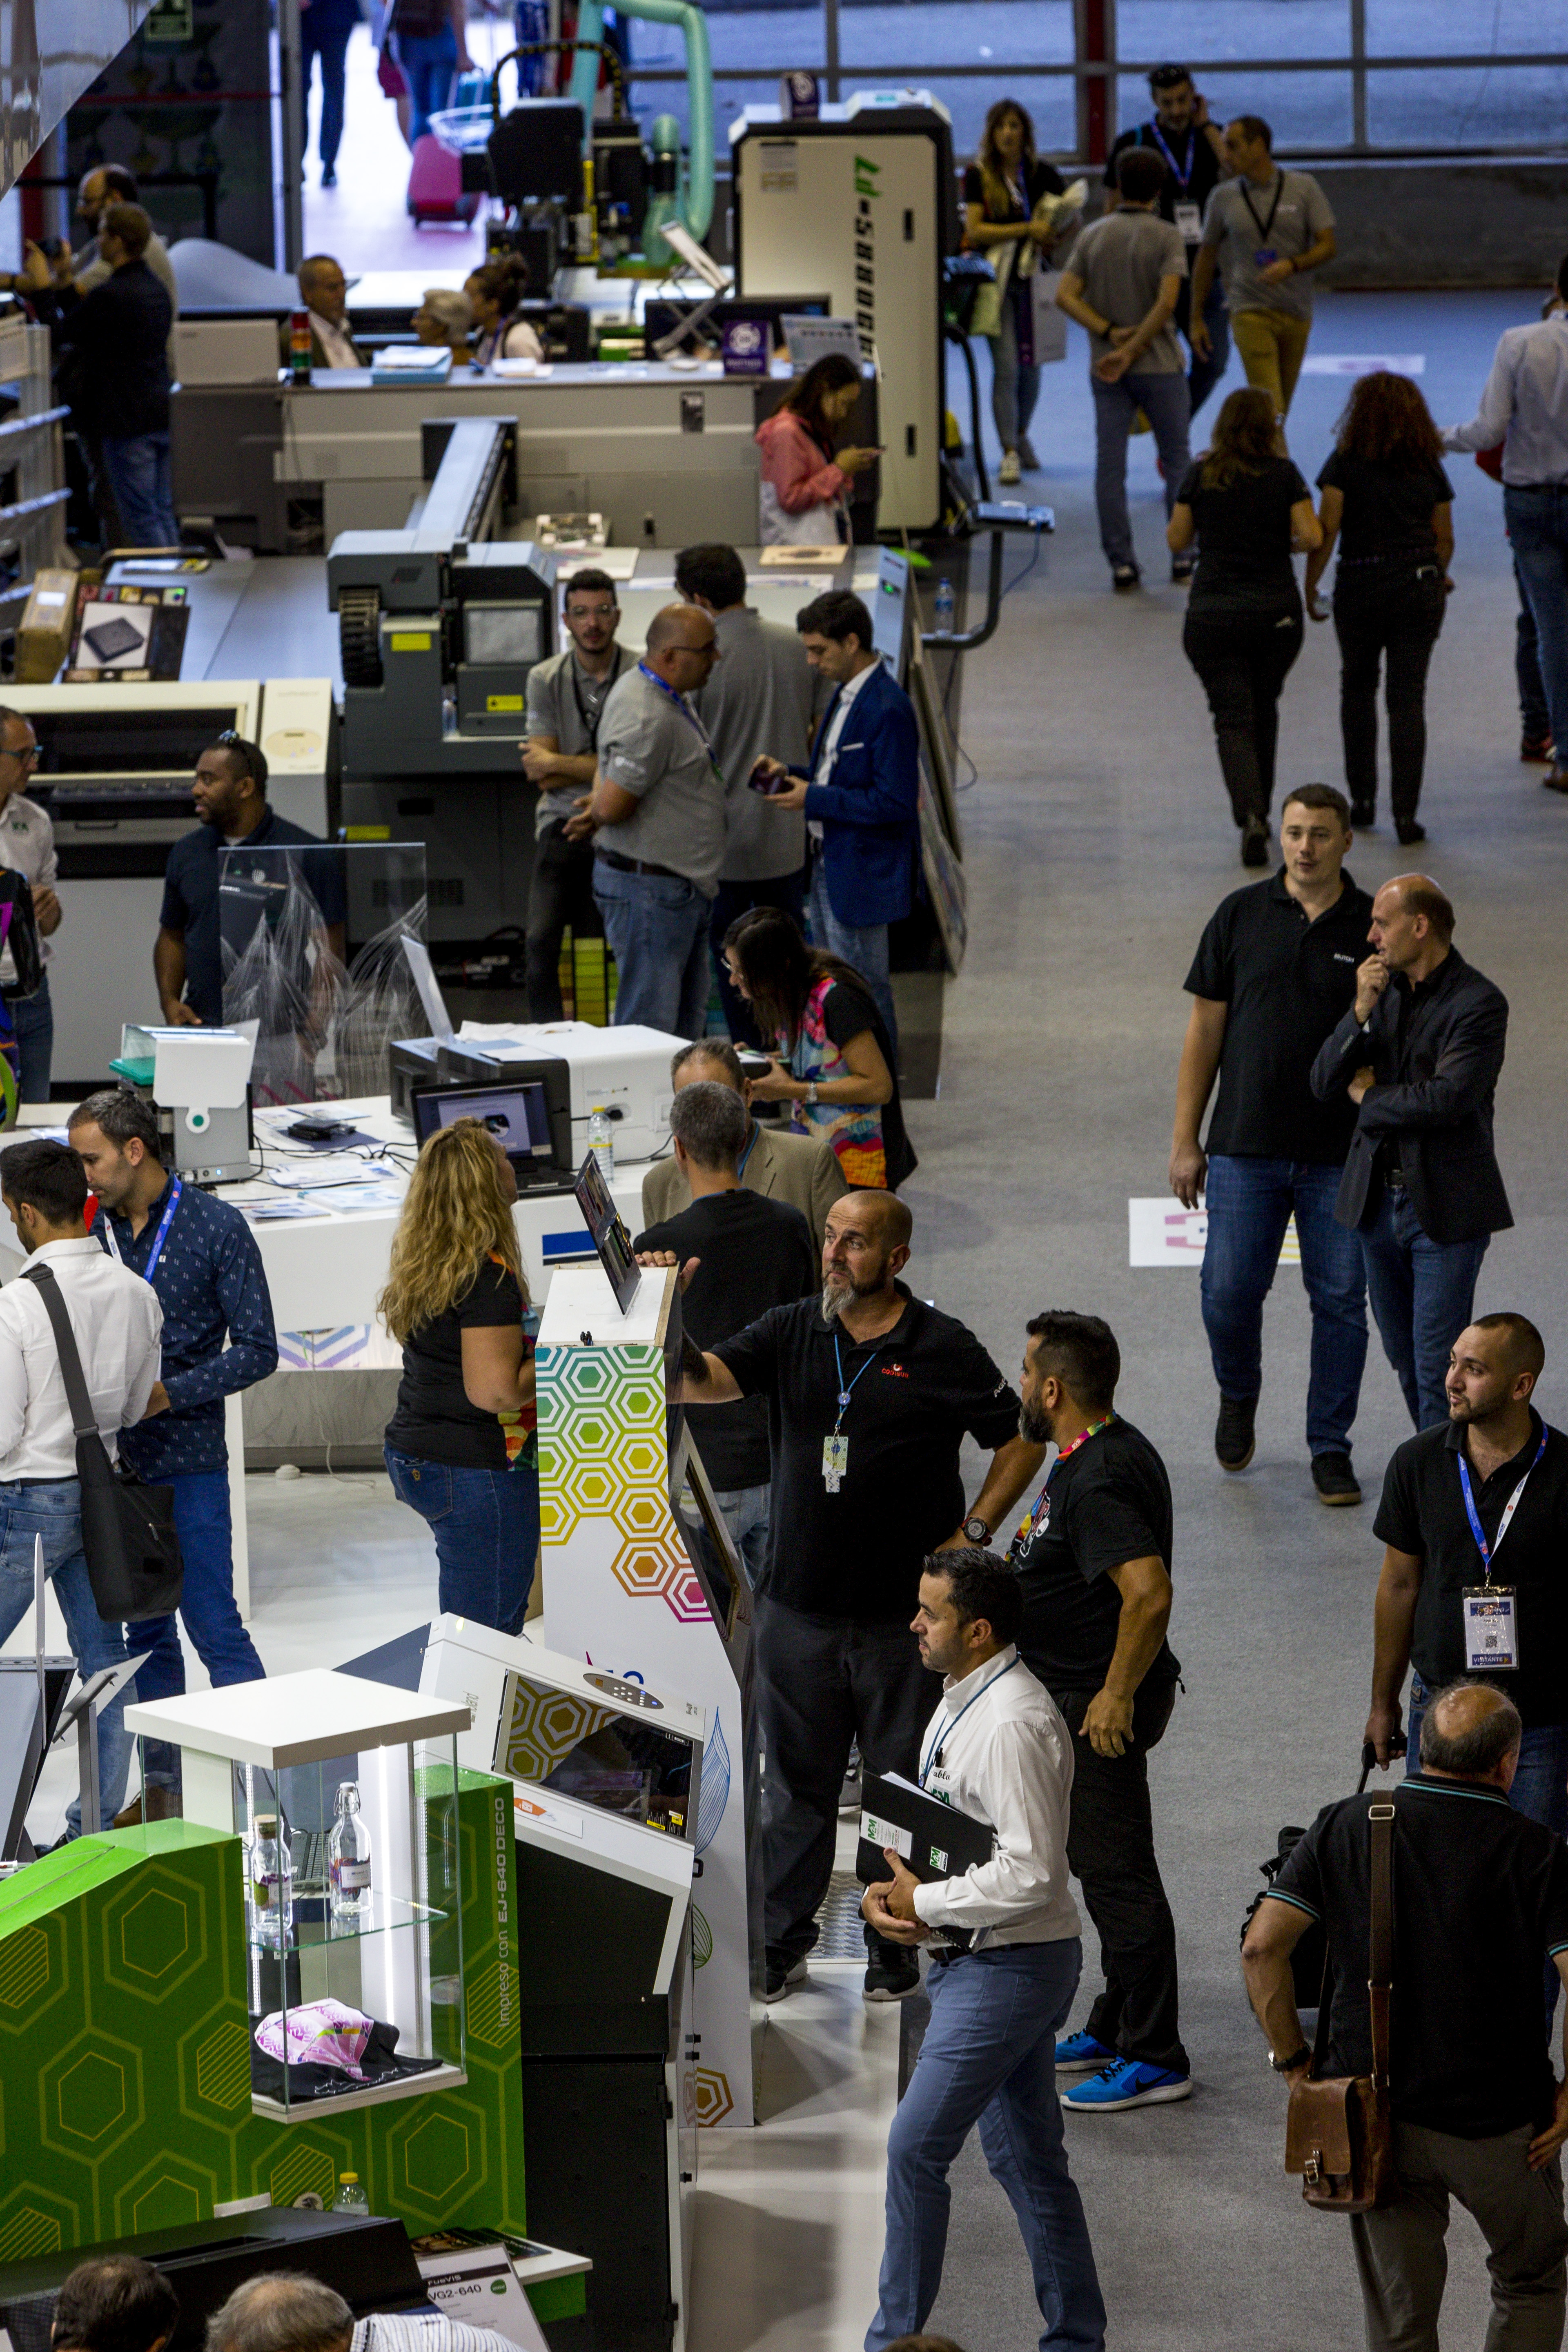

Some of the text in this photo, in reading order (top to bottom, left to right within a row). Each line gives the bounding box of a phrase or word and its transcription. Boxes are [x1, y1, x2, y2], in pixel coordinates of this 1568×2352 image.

[932, 1769, 951, 1781] ablo
[868, 1818, 877, 1840] M2M
[931, 1848, 940, 1867] M2M
[495, 1797, 512, 2028] Impreso con EJ-640 DECO
[428, 2284, 481, 2301] VG2-640
